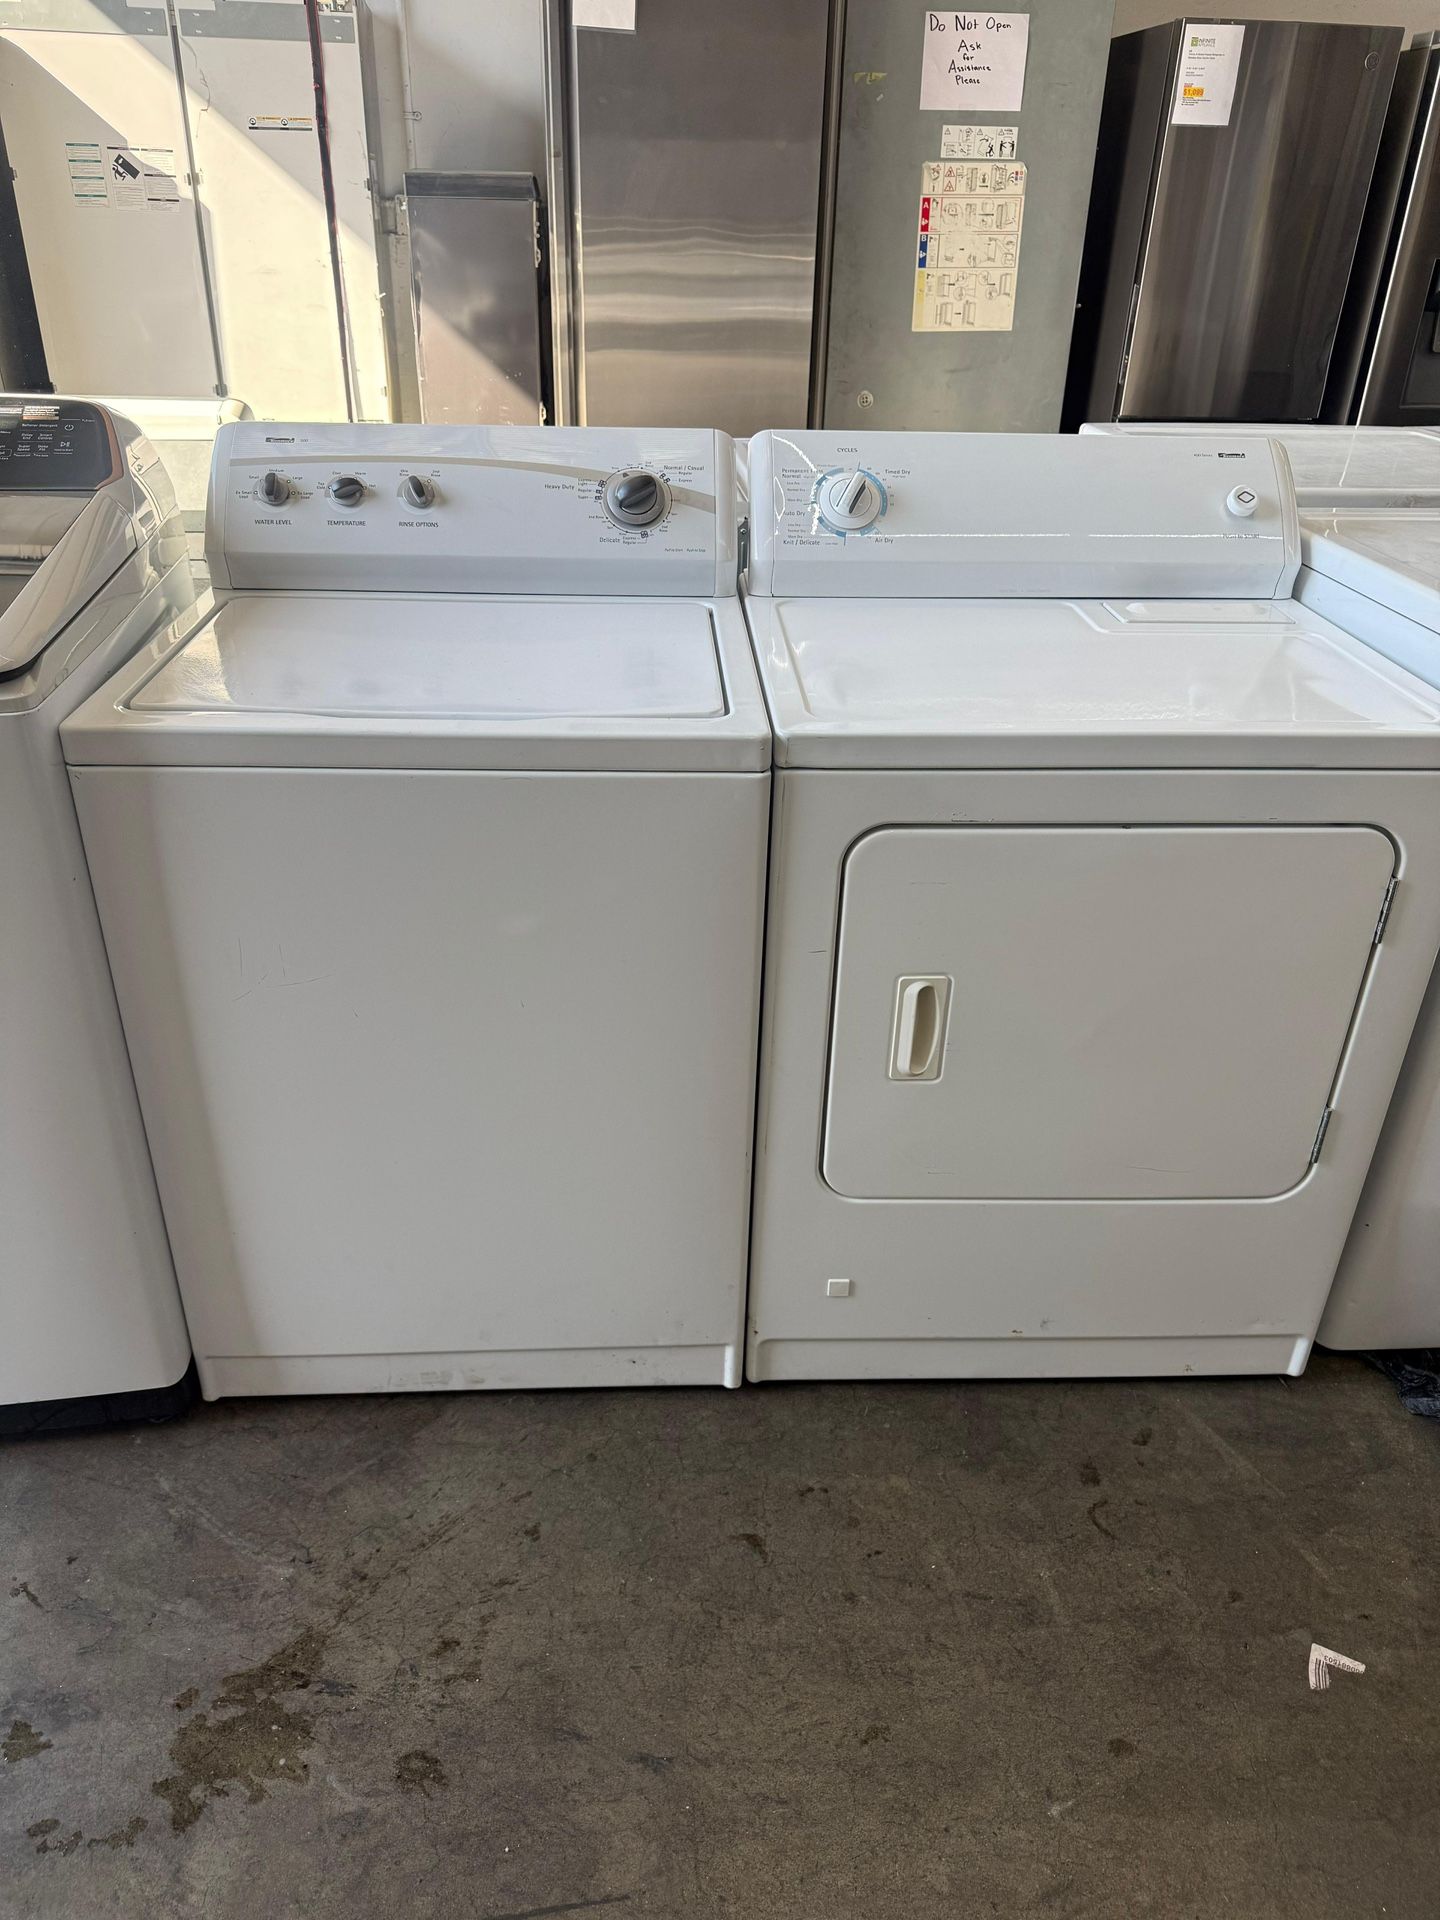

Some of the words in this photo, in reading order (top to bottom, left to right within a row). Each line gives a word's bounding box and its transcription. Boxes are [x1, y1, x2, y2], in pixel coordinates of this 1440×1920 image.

[929, 13, 946, 32] Do
[955, 14, 979, 32] Not
[985, 16, 1012, 33] Open
[957, 39, 982, 53] Ask
[962, 53, 975, 61] for
[948, 59, 992, 74] Assistance
[955, 74, 981, 86] Please
